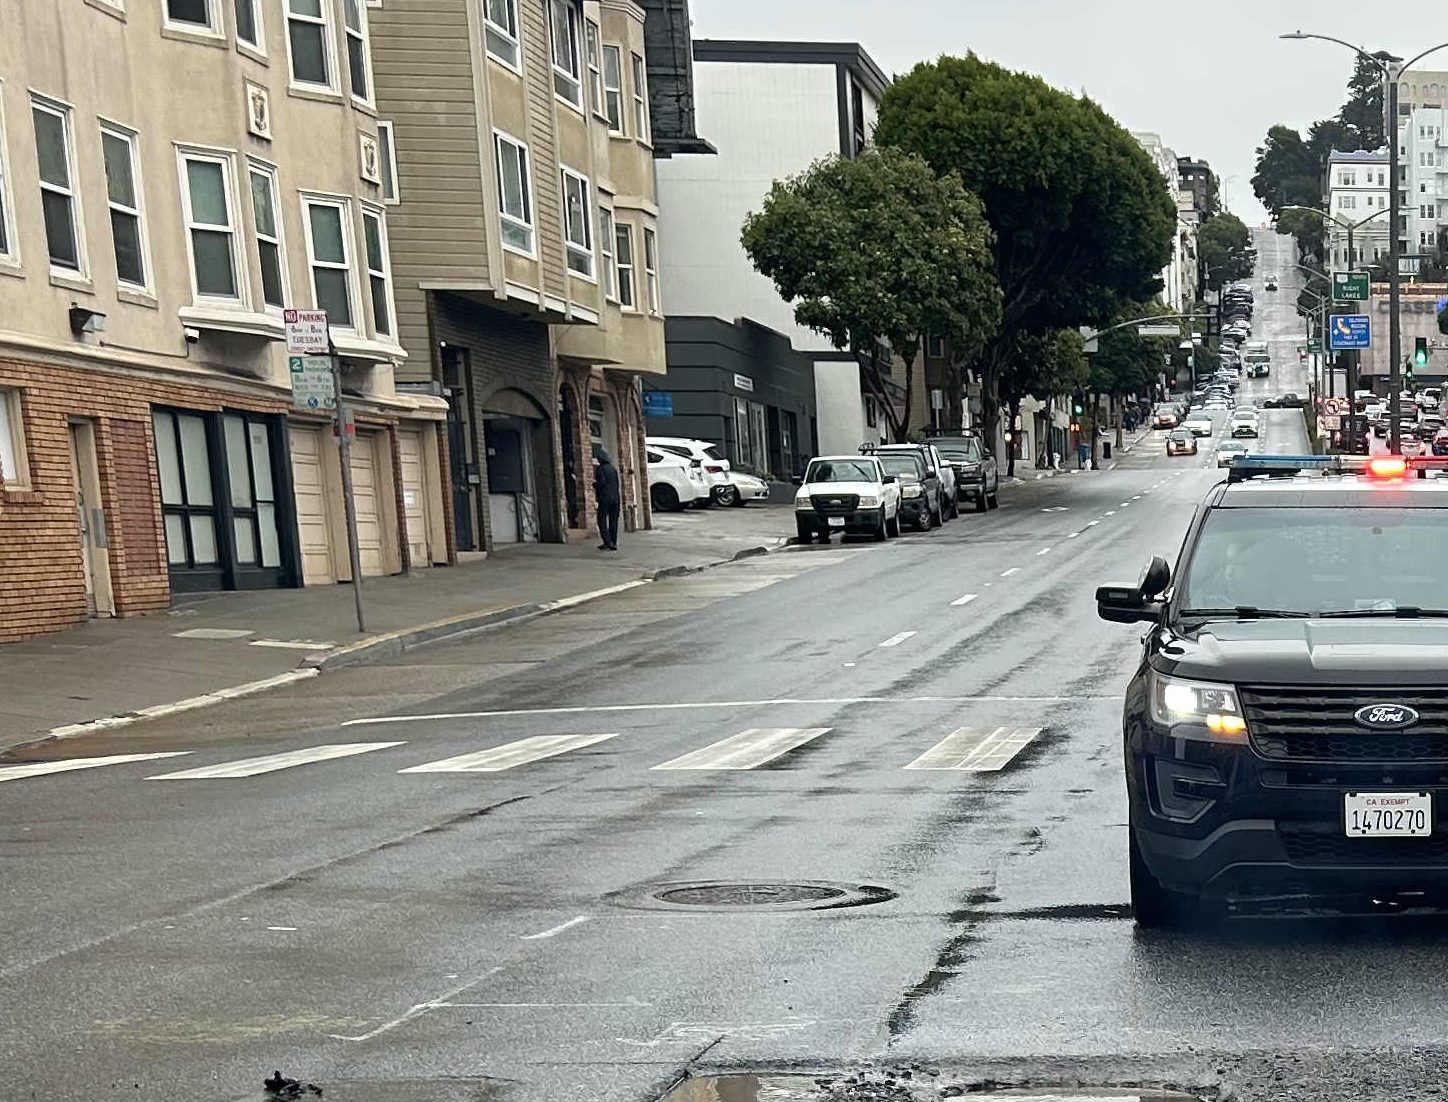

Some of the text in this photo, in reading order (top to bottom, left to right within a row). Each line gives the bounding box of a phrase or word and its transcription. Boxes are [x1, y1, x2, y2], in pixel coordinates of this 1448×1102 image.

[298, 314, 324, 322] PARKING
[292, 359, 301, 371] 2
[1368, 707, 1404, 722] Ford
[1352, 809, 1425, 830] 1470270
